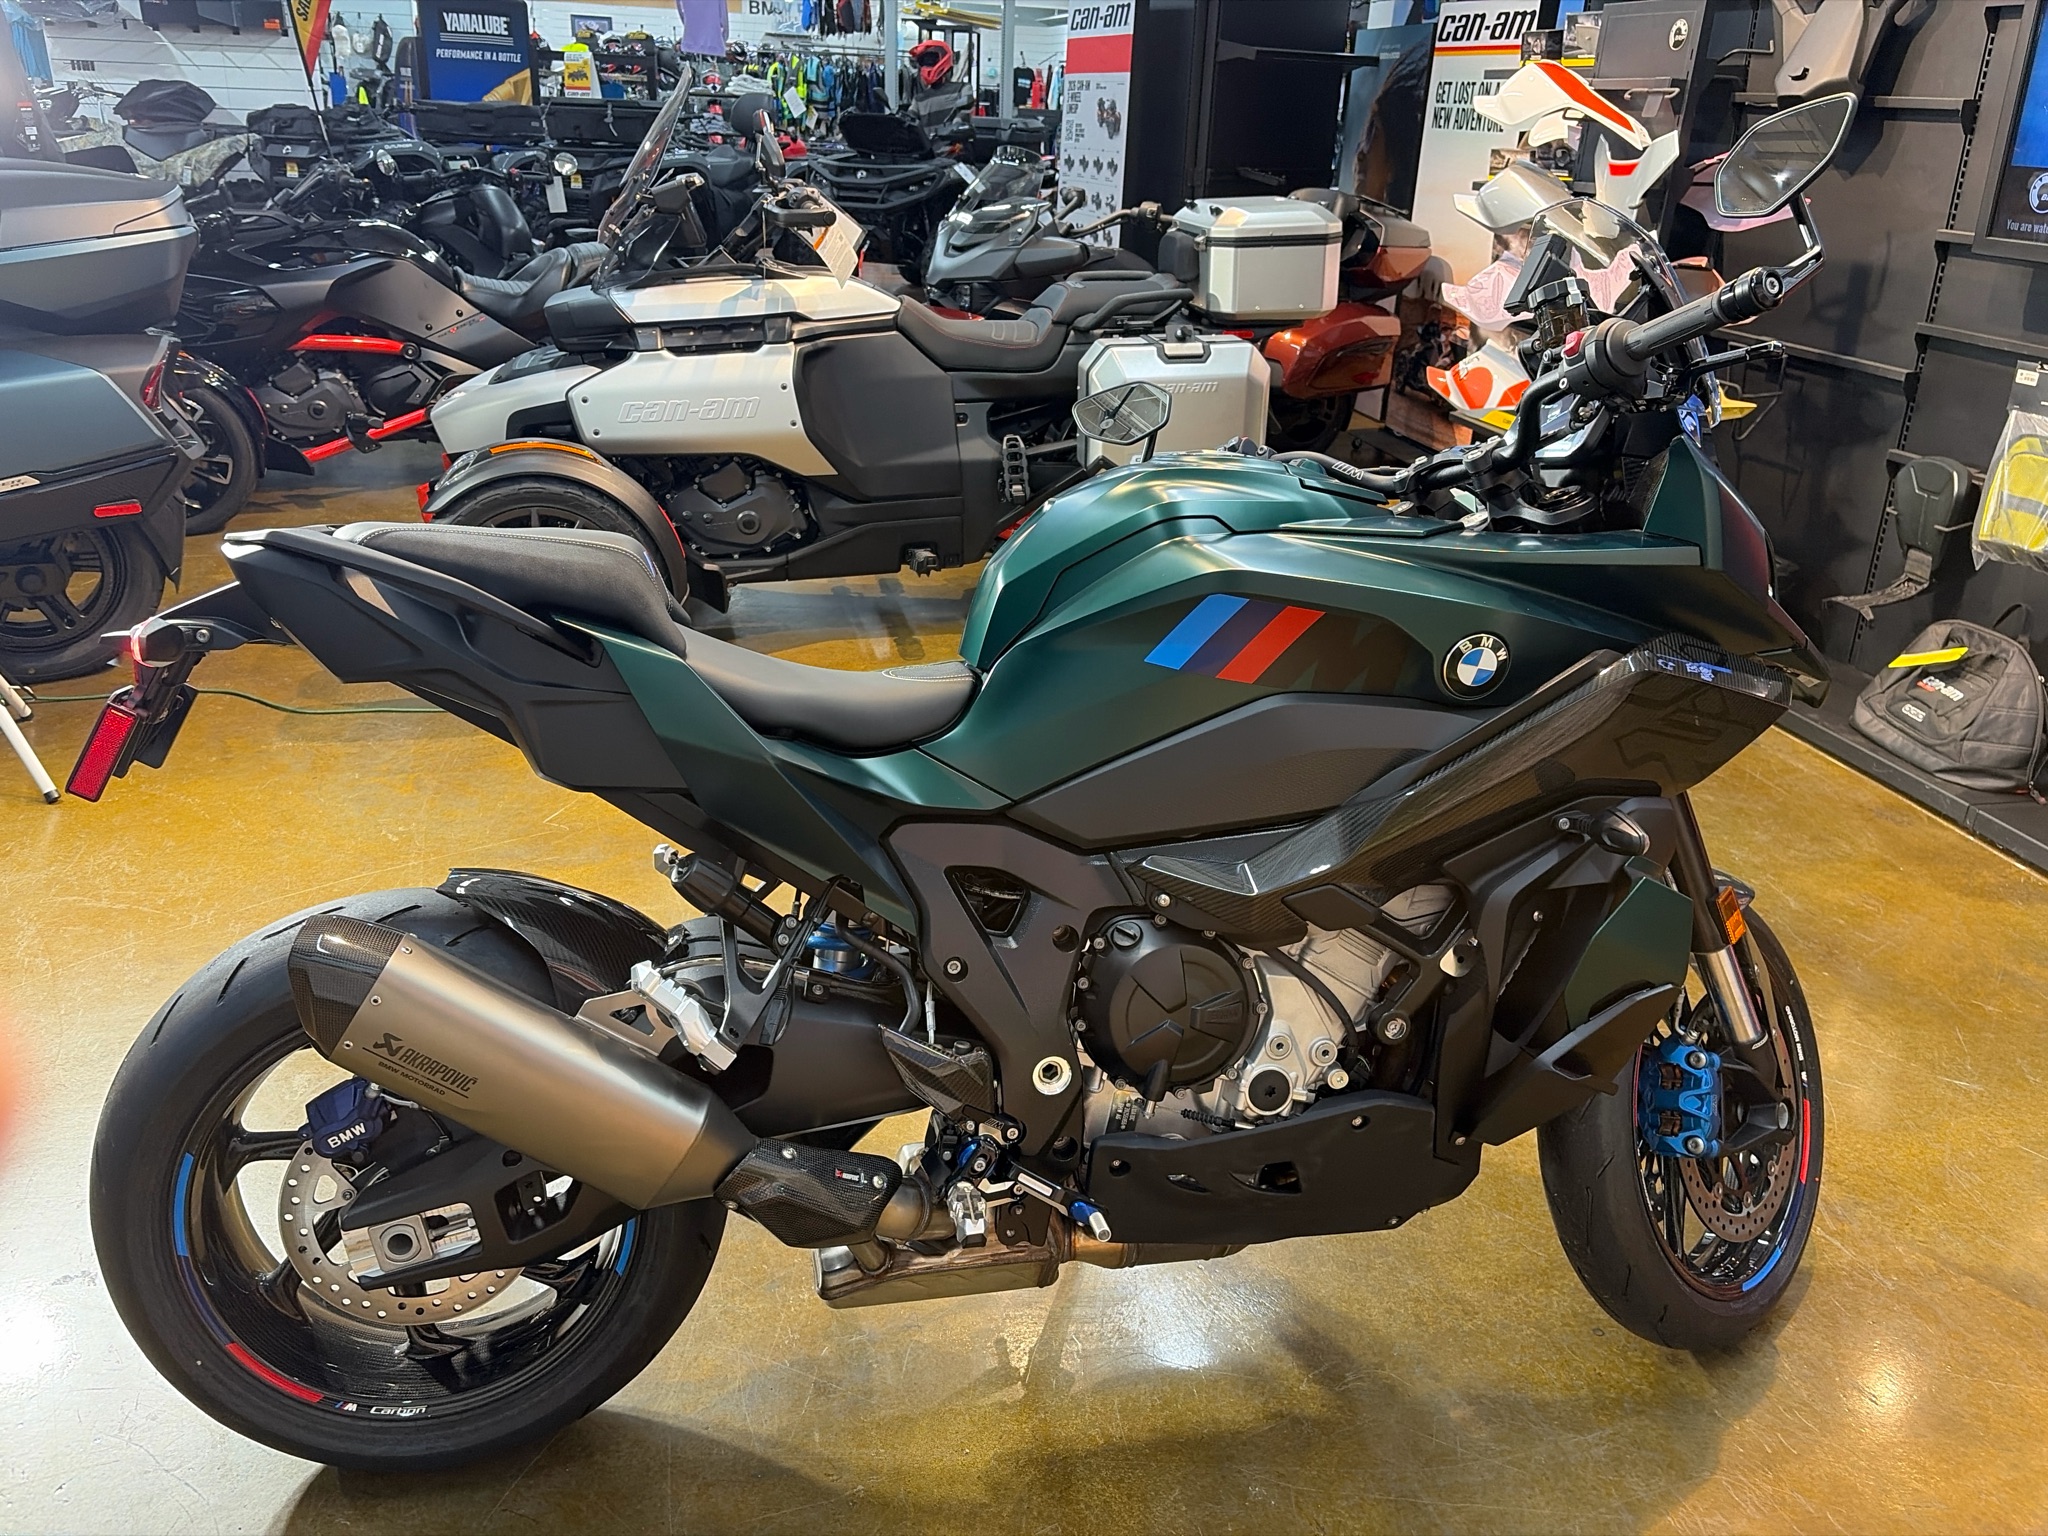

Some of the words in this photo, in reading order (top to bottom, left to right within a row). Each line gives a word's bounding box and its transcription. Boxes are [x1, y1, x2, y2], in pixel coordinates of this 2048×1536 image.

[442, 12, 509, 35] YAMALUBE
[1070, 2, 1131, 31] can-am
[1438, 10, 1537, 42] can-am
[436, 48, 482, 60] PERFORMANCE
[483, 51, 492, 60] IN
[492, 51, 498, 61] A
[498, 52, 521, 63] BOTTLE
[1436, 81, 1453, 104] GET
[1453, 82, 1476, 104] LOST
[1431, 107, 1453, 129] NEW
[2007, 219, 2019, 231] You
[2020, 222, 2032, 232] are
[617, 396, 760, 423] can-am
[1459, 636, 1508, 661] BMW
[378, 1061, 400, 1074] BMW
[400, 1071, 446, 1096] MOTORRAD
[327, 1122, 366, 1149] BMW
[369, 1404, 428, 1416] Carbon
